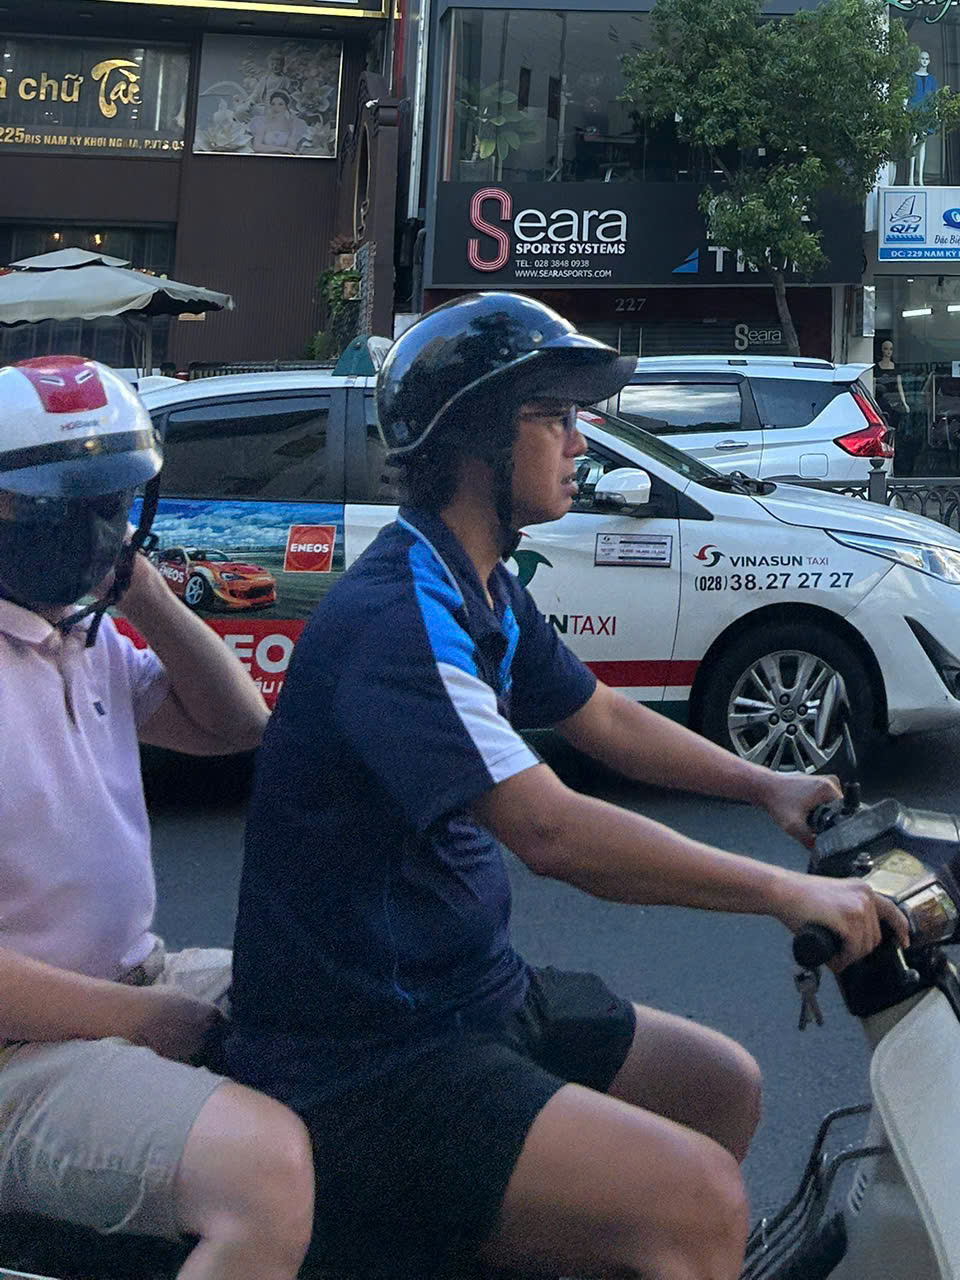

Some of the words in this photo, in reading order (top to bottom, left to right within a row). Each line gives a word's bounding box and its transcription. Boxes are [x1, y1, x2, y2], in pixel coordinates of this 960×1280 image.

[18, 72, 85, 103] chữ
[91, 58, 143, 119] Tài
[44, 135, 67, 146] NAM
[467, 186, 627, 272] Seara
[889, 223, 920, 233] QH
[515, 242, 566, 254] SPORTS
[569, 242, 626, 254] SYSTEMS
[945, 249, 956, 257] KỲ
[516, 259, 532, 267] TEL:
[534, 259, 549, 267] 028
[550, 259, 569, 267] 3848
[571, 259, 590, 267] 0938
[514, 270, 612, 278] WWW.SEARASPORTS.COM
[615, 298, 647, 312] 227
[734, 323, 782, 350] Seara
[290, 543, 329, 553] ENEOS
[729, 556, 803, 567] VINASUN
[806, 556, 829, 566] TAXI
[798, 572, 822, 589] 27
[829, 572, 854, 588] 27
